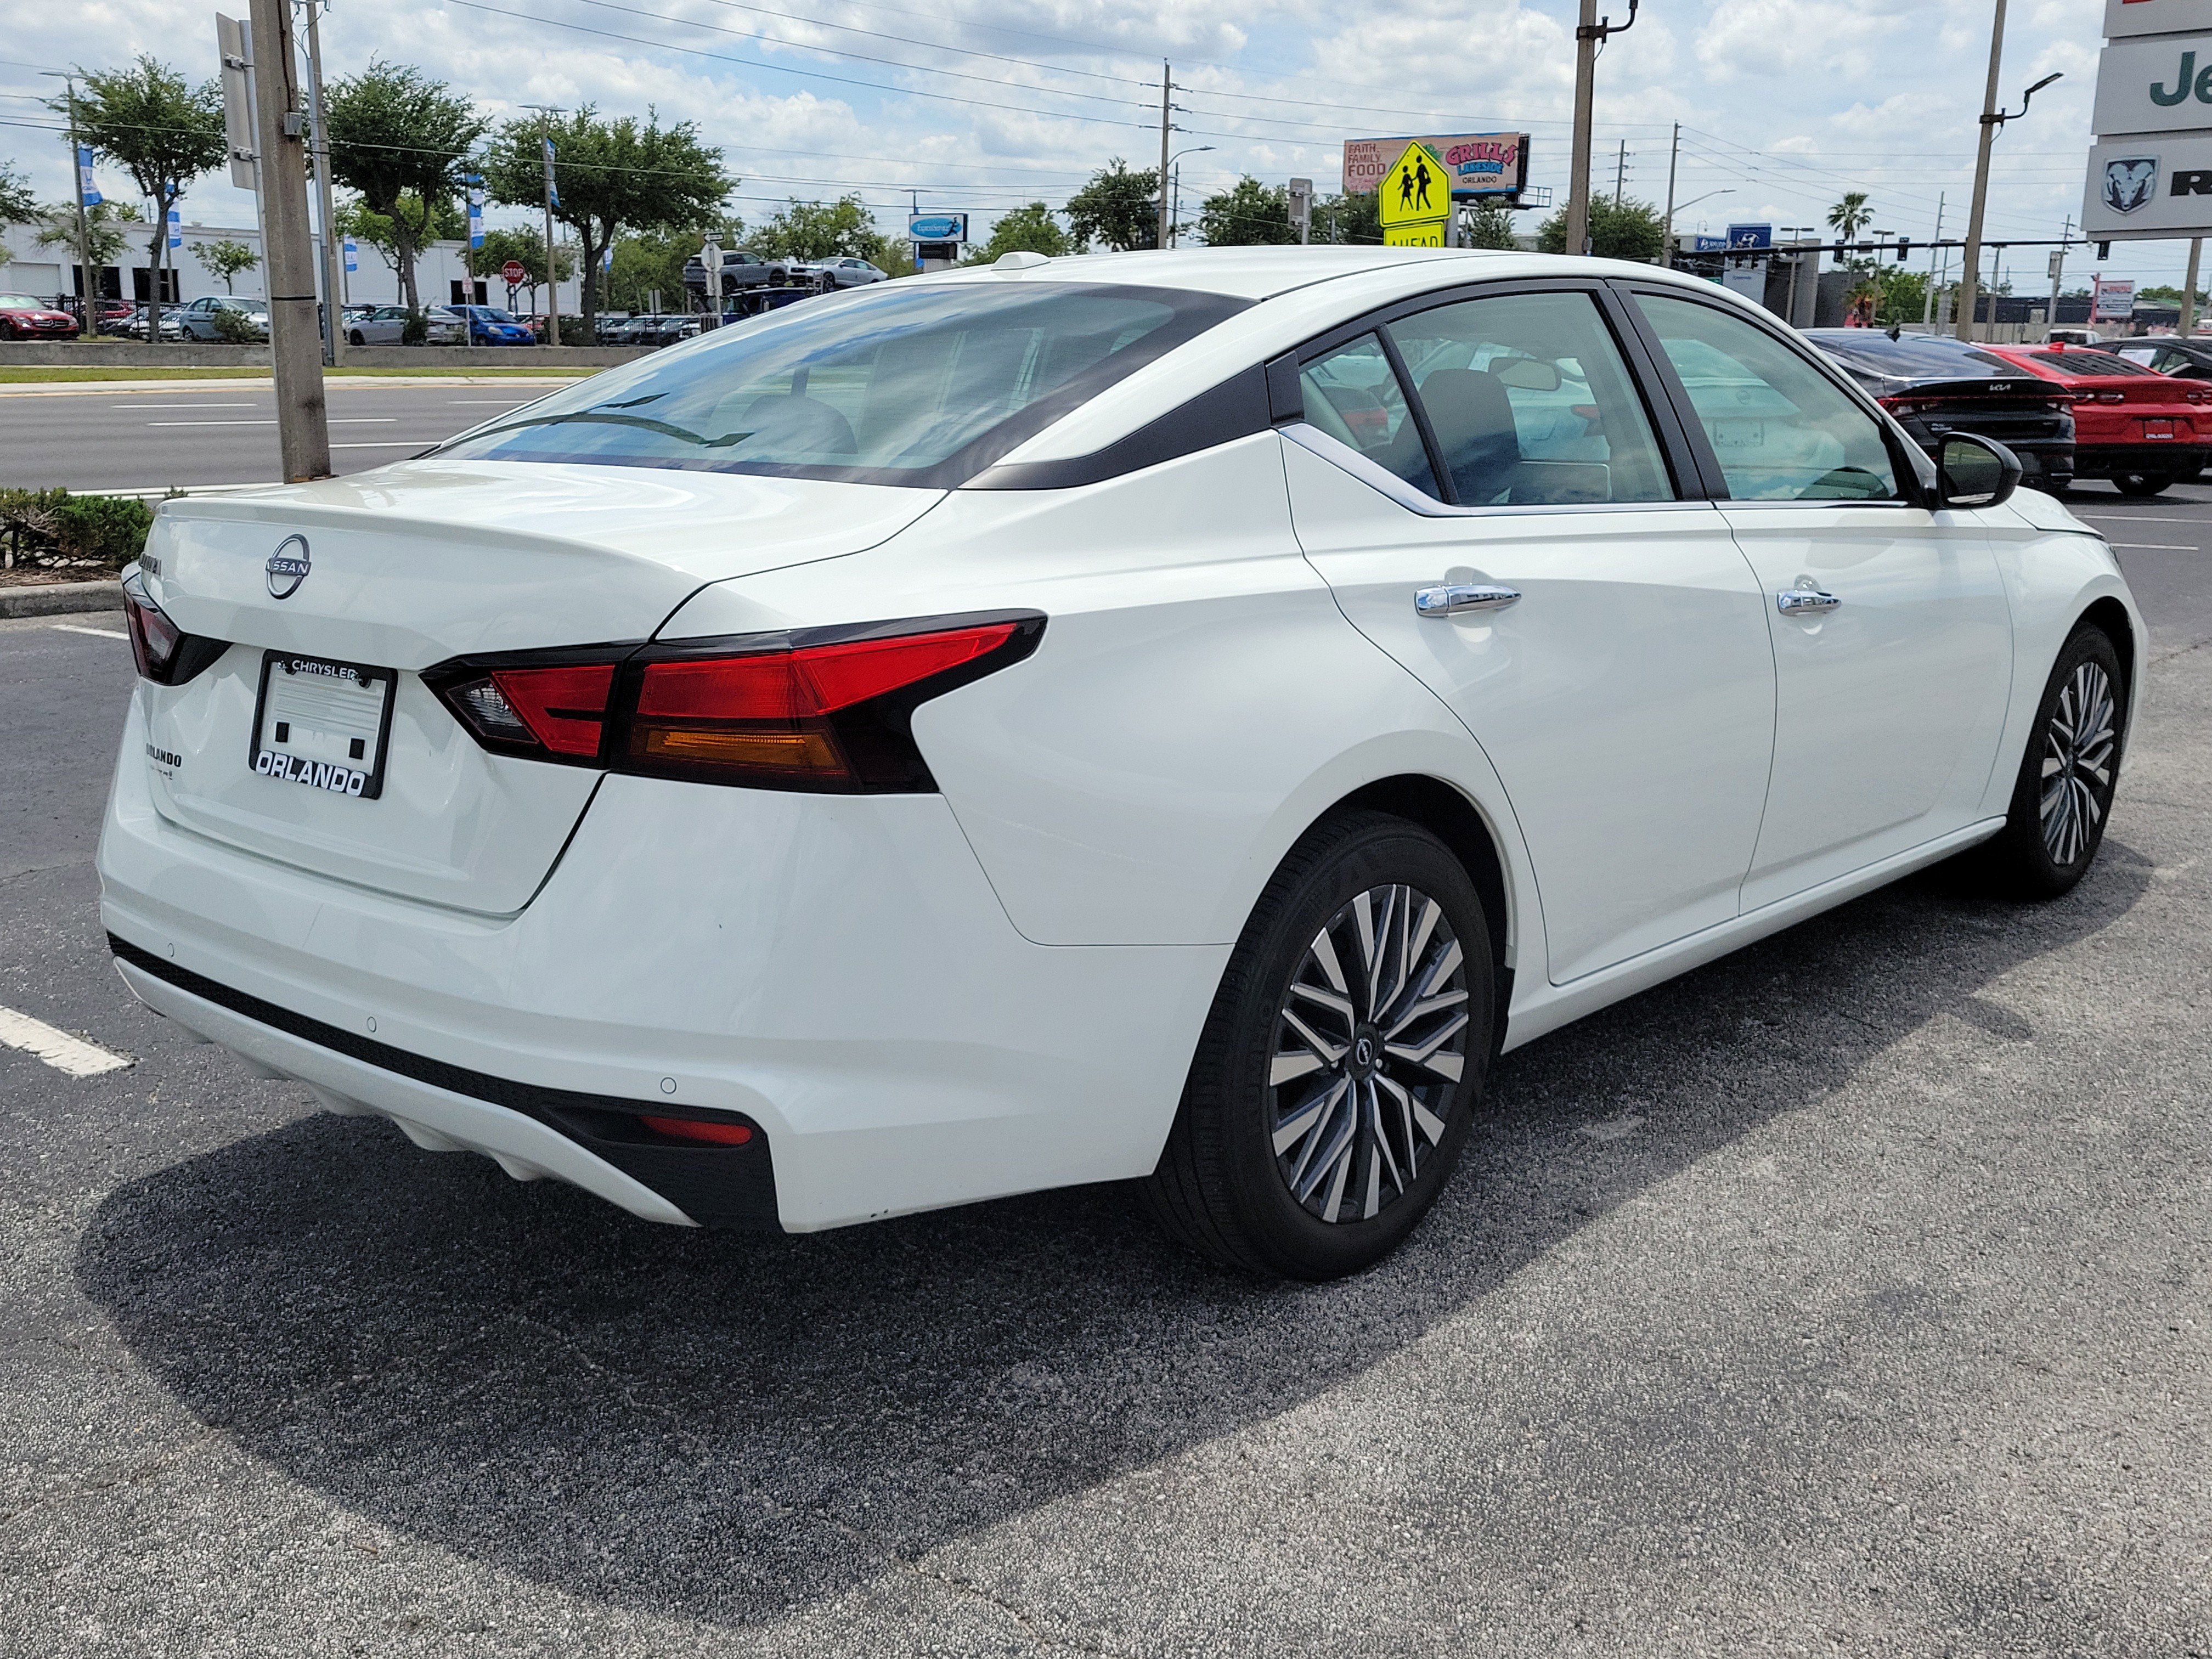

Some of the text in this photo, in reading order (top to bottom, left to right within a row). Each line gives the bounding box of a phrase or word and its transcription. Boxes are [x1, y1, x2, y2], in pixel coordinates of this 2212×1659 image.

[1446, 142, 1517, 166] GRILLS
[1348, 163, 1385, 176] FOOD
[504, 268, 523, 278] STOP
[267, 560, 309, 574] SSAN
[256, 750, 365, 797] ORLANDO
